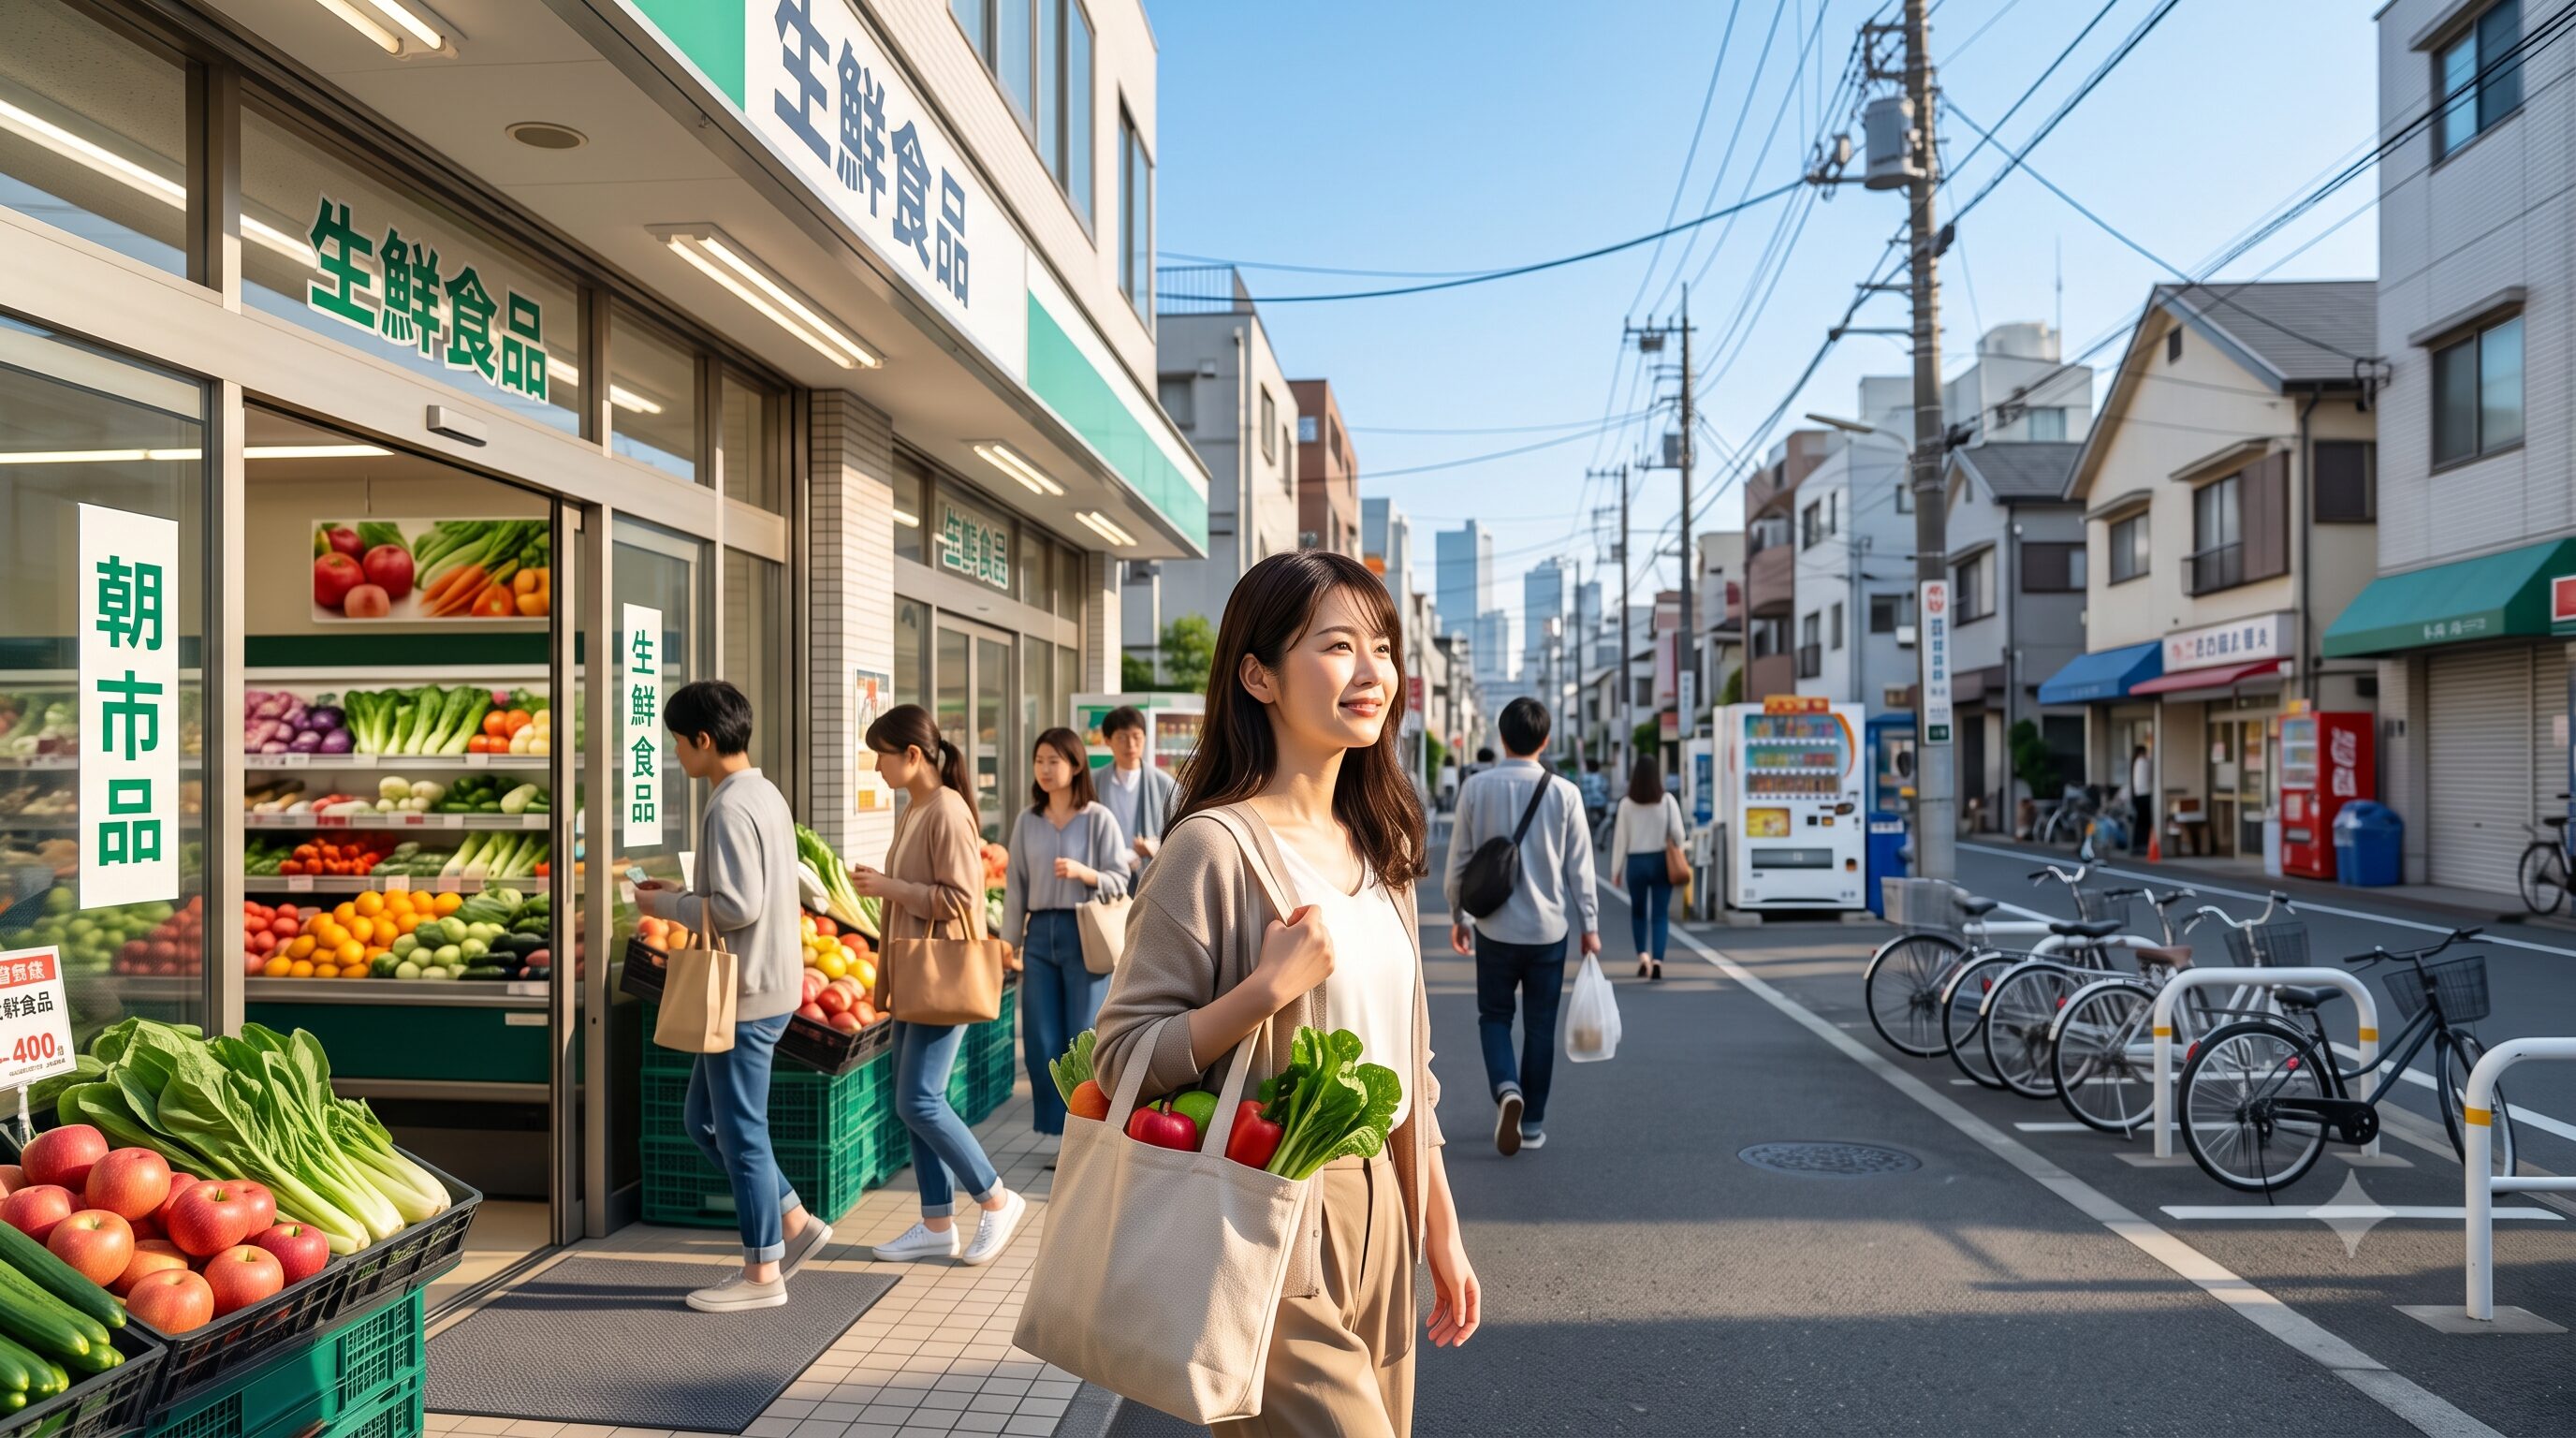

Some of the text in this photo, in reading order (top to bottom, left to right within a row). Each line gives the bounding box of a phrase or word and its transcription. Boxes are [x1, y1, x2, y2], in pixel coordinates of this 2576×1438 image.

[774, 0, 970, 309] 生鮮食品
[309, 195, 549, 403] 生鮮食品
[95, 554, 164, 867] 朝市品
[630, 628, 656, 824] 生鮮食品
